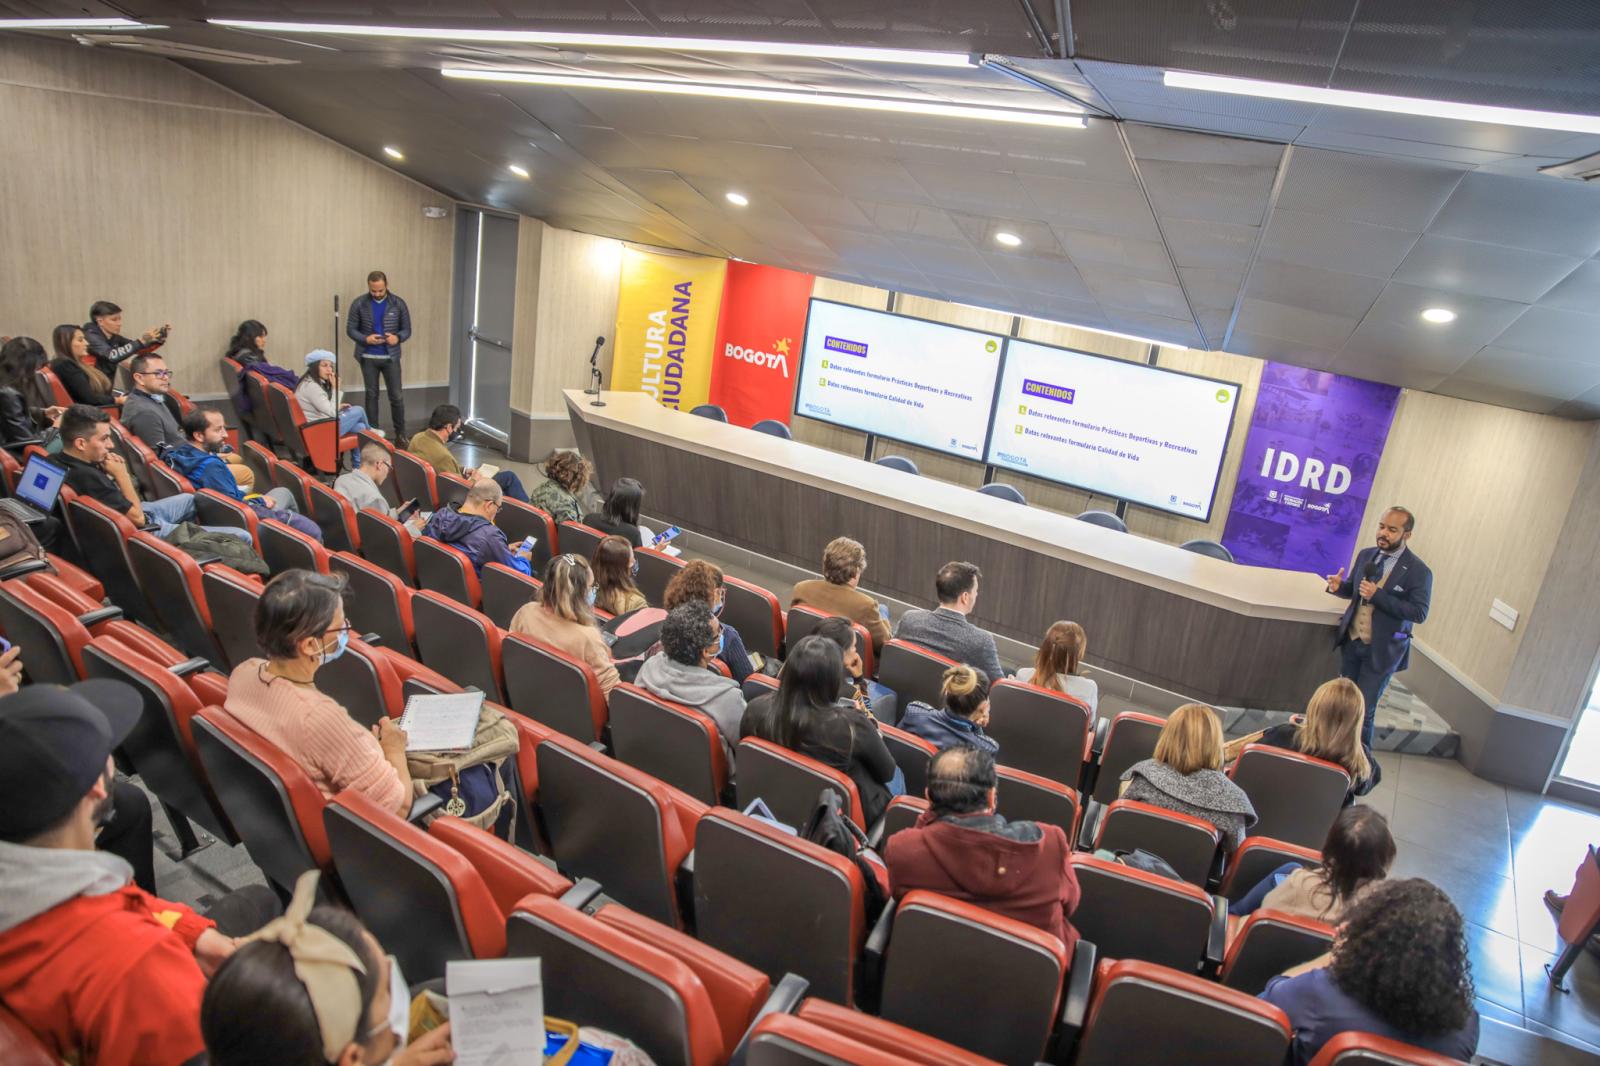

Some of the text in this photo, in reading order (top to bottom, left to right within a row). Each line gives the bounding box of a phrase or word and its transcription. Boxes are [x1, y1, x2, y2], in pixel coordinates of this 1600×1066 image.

[641, 310, 667, 400] ULTURA
[662, 281, 692, 411] IUDADANA
[827, 338, 867, 354] CONTENIDOS
[827, 380, 840, 389] Datos
[840, 384, 863, 395] relevantes
[863, 389, 888, 400] formulario
[888, 395, 906, 404] Calidad
[906, 399, 913, 407] de
[913, 401, 925, 409] Vida
[829, 362, 843, 371] Datos
[843, 367, 866, 377] relevantes
[866, 373, 891, 383] formulario
[914, 382, 940, 394] Deportivas
[943, 389, 973, 401] Recreativas
[1026, 382, 1073, 401] CONTENIDOS
[1024, 427, 1039, 437] Datos
[1040, 432, 1067, 444] relevantes
[1068, 438, 1097, 451] formulario
[1097, 445, 1119, 456] Calidad
[1119, 450, 1126, 458] de
[1127, 452, 1140, 462] Vida
[1028, 408, 1043, 418] Datos
[1044, 413, 1071, 425] relevantes
[1072, 419, 1101, 432] formulario
[1101, 426, 1128, 438] Prácticas
[1128, 433, 1158, 446] Deportivas
[1164, 441, 1198, 455] Recreativas
[1260, 447, 1352, 495] IDRD
